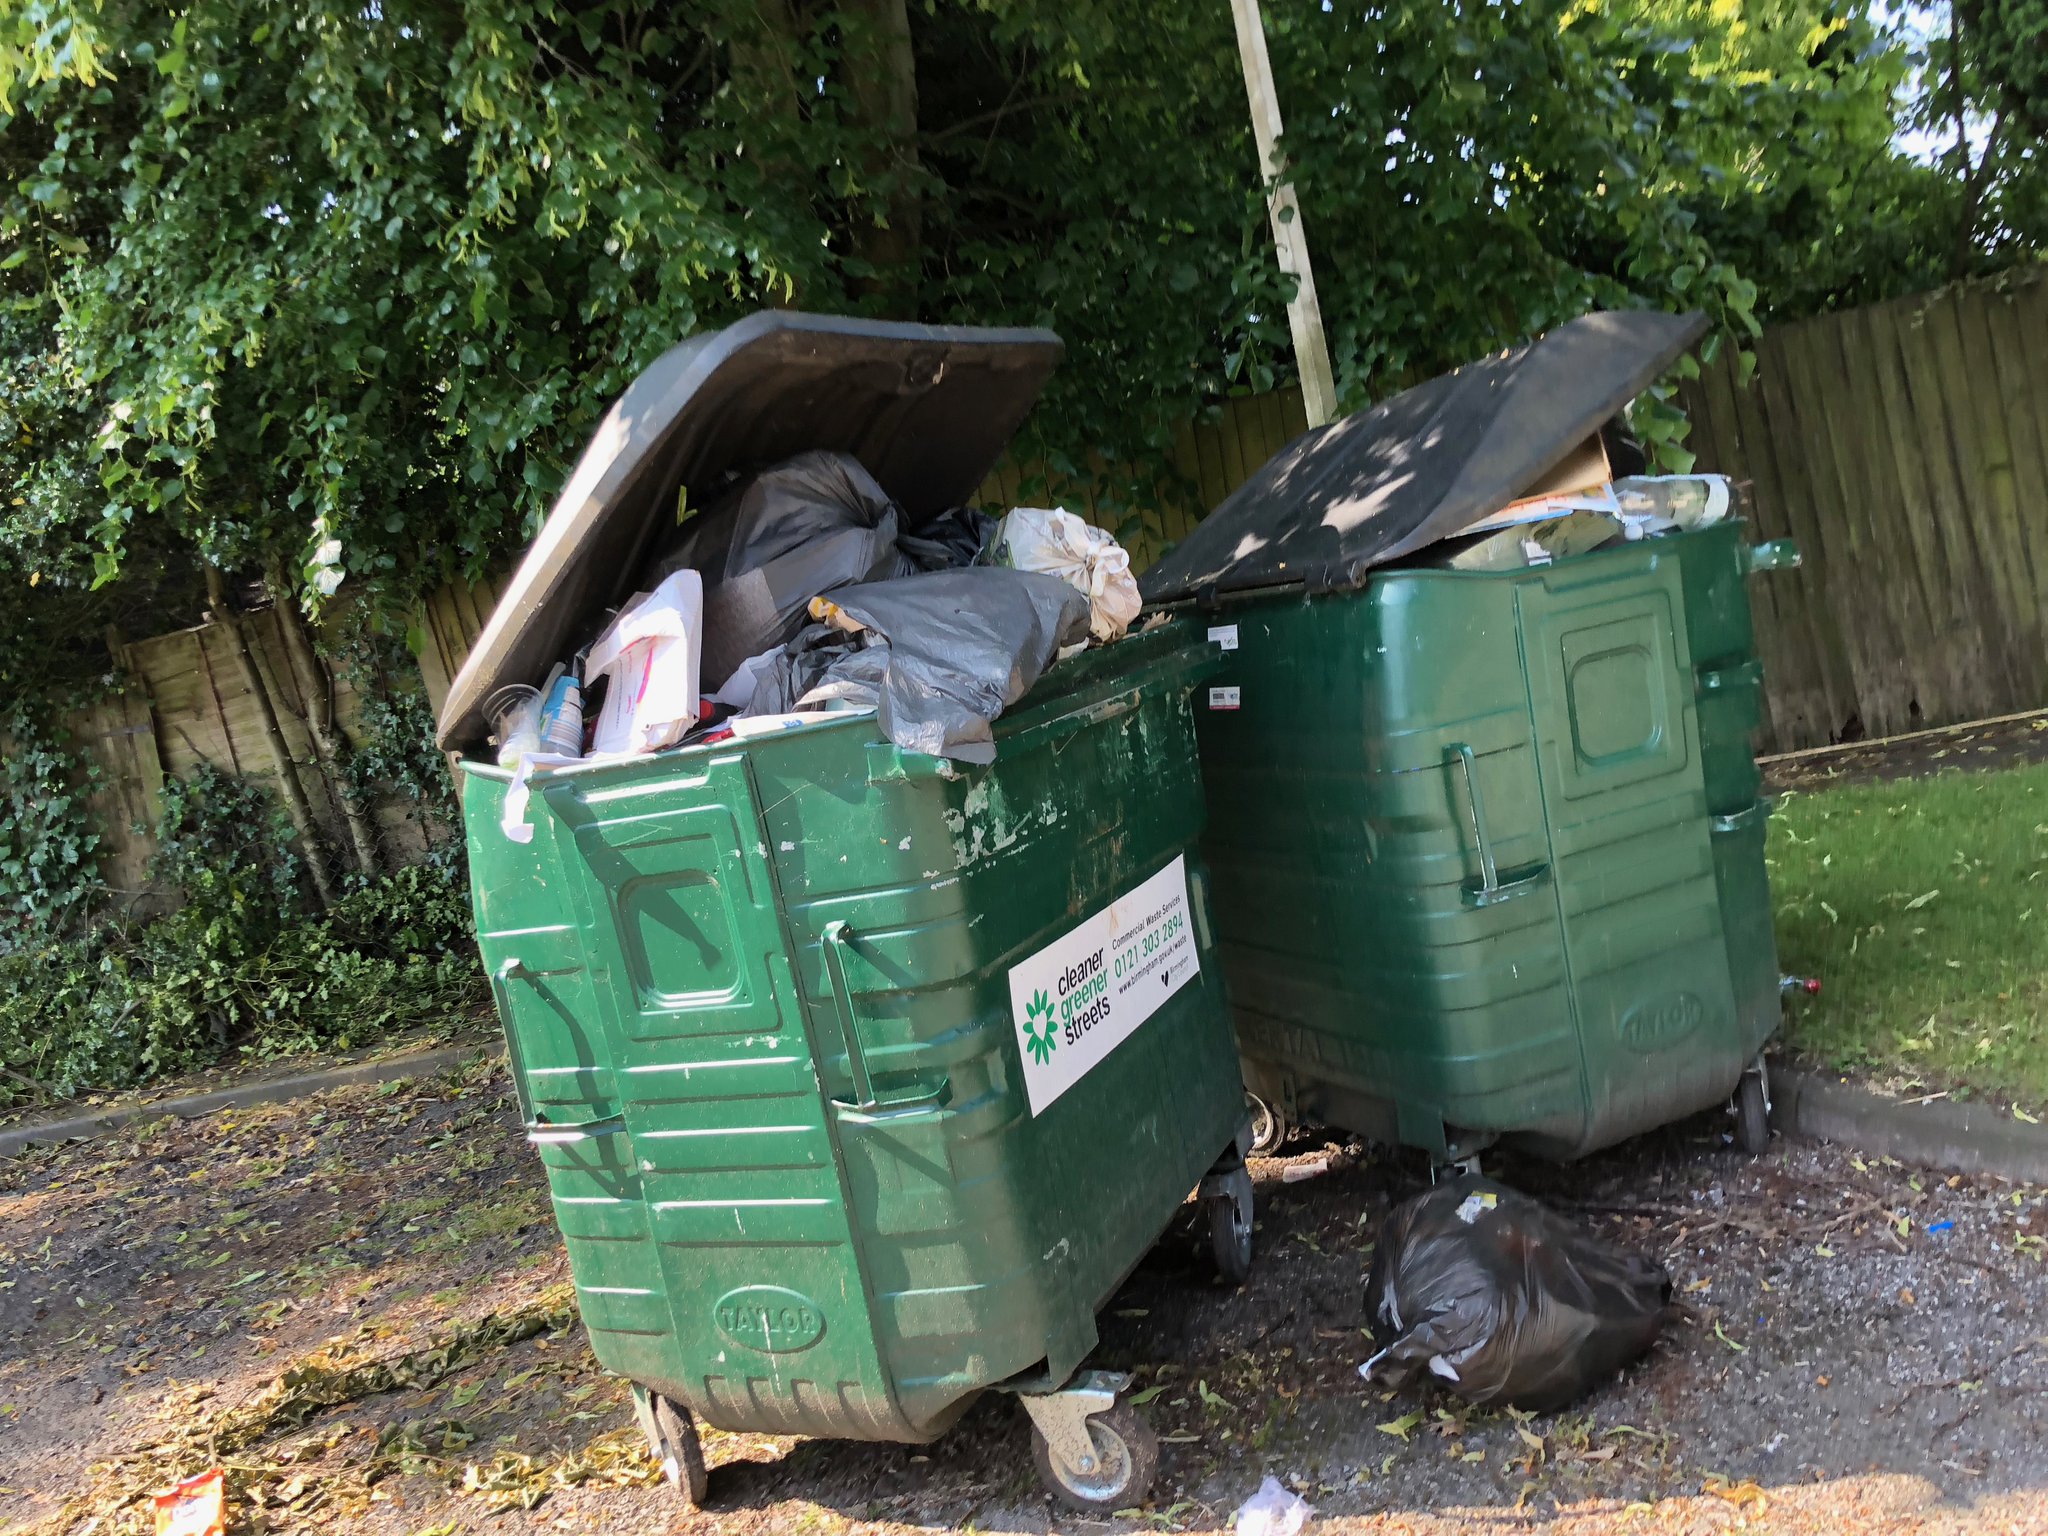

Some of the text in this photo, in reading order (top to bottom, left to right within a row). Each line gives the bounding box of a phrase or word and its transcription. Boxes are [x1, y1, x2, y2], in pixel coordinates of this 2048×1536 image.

[1112, 894, 1181, 951] Commercial Waste Services
[1114, 944, 1139, 978] 0121
[1142, 929, 1160, 958] 303
[1162, 910, 1184, 942] 2894
[1058, 946, 1104, 997] cleaner
[1060, 967, 1109, 1028] greener
[1064, 995, 1111, 1046] streets
[720, 1304, 816, 1334] TAYLOR
